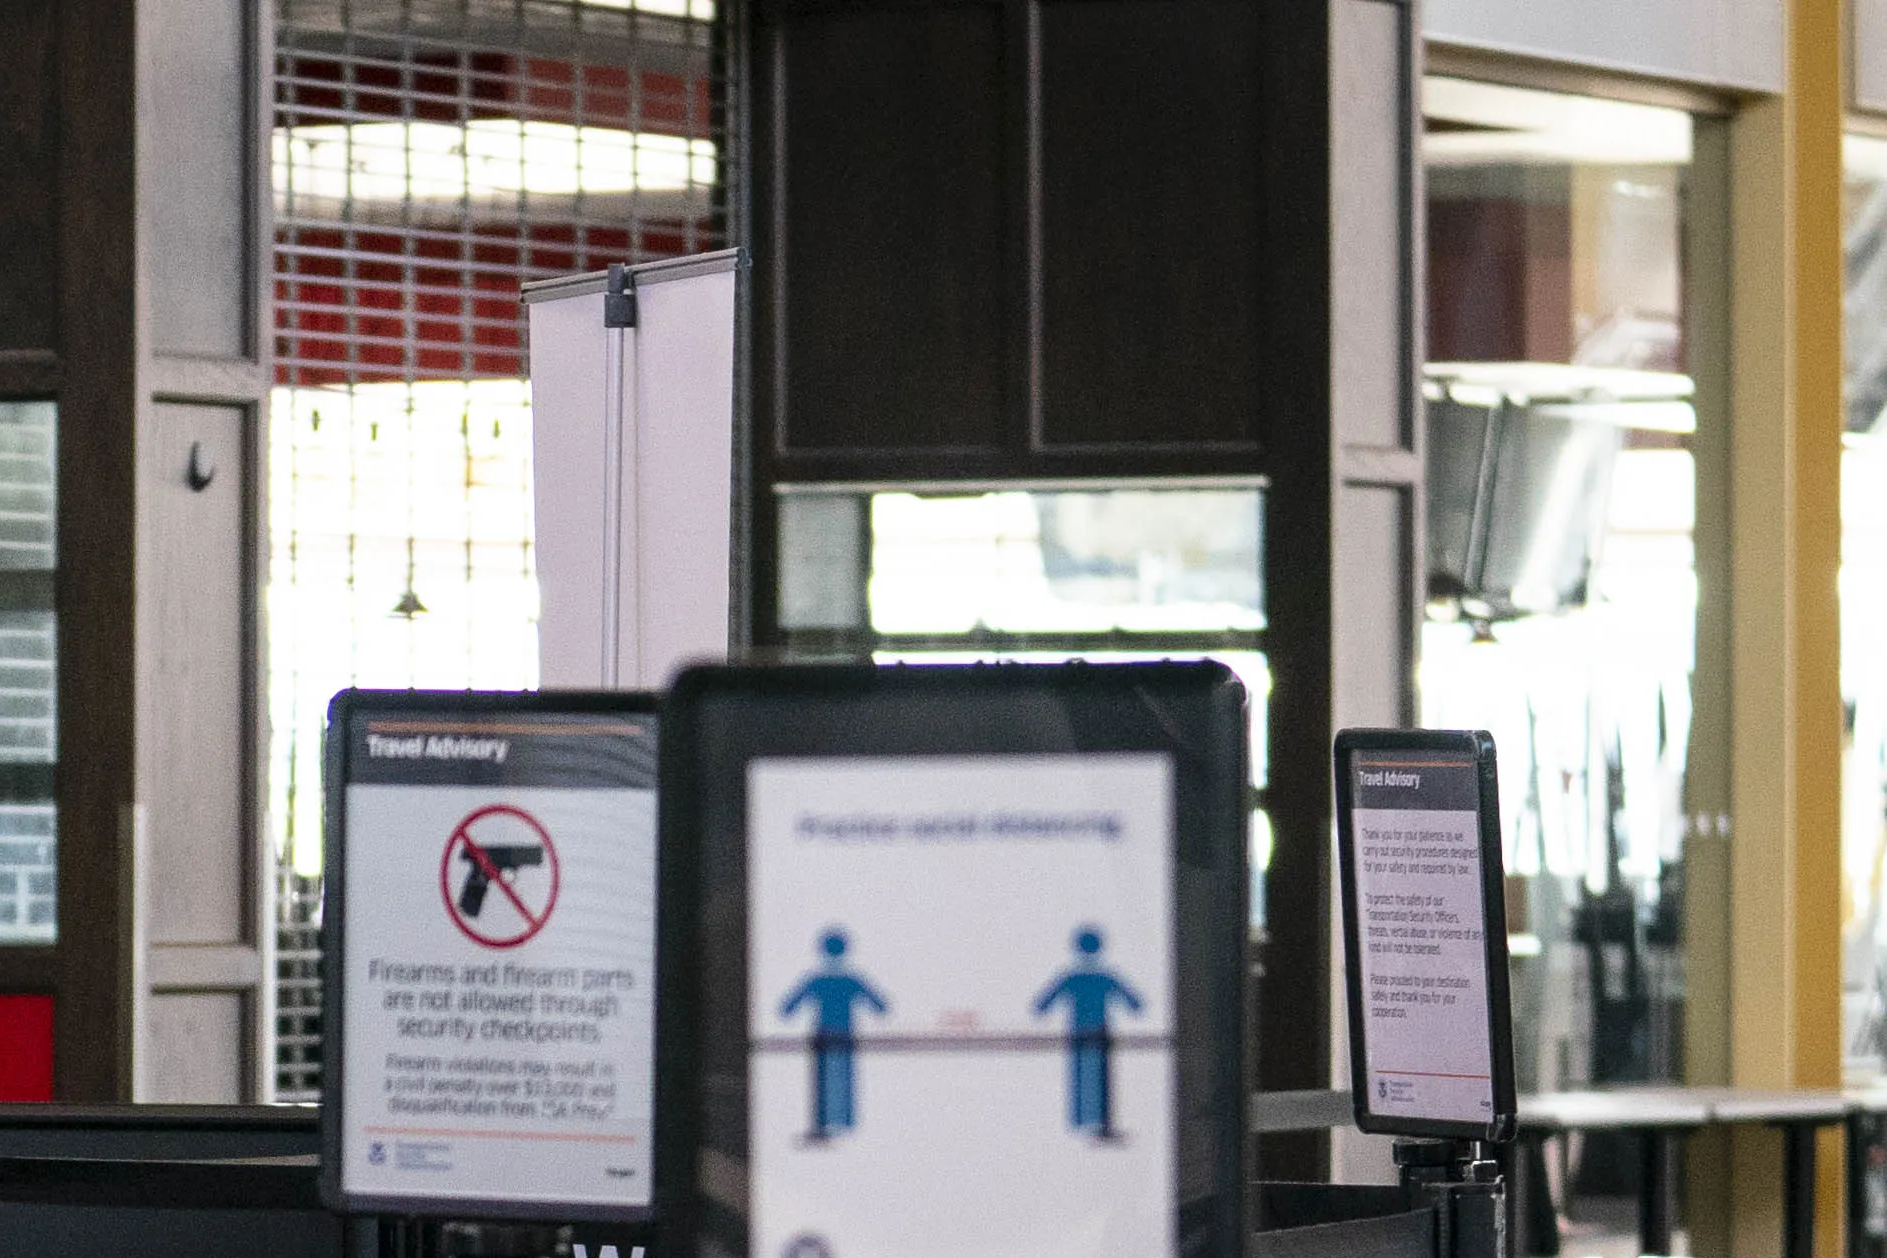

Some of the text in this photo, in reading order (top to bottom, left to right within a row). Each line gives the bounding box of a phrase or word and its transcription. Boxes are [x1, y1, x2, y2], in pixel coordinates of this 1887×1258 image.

[367, 735, 510, 763] Travel Advisory
[1359, 770, 1420, 790] Travel Advisory
[1404, 831, 1417, 843] your
[1379, 846, 1389, 857] out
[1390, 846, 1414, 860] security
[1415, 847, 1449, 860] procedures
[1374, 863, 1387, 875] your
[1388, 861, 1407, 875] safety
[1408, 863, 1419, 874] and
[368, 958, 635, 991] Firearms and firearm parts
[383, 990, 618, 1019] are not allowed through
[397, 1016, 475, 1041] security
